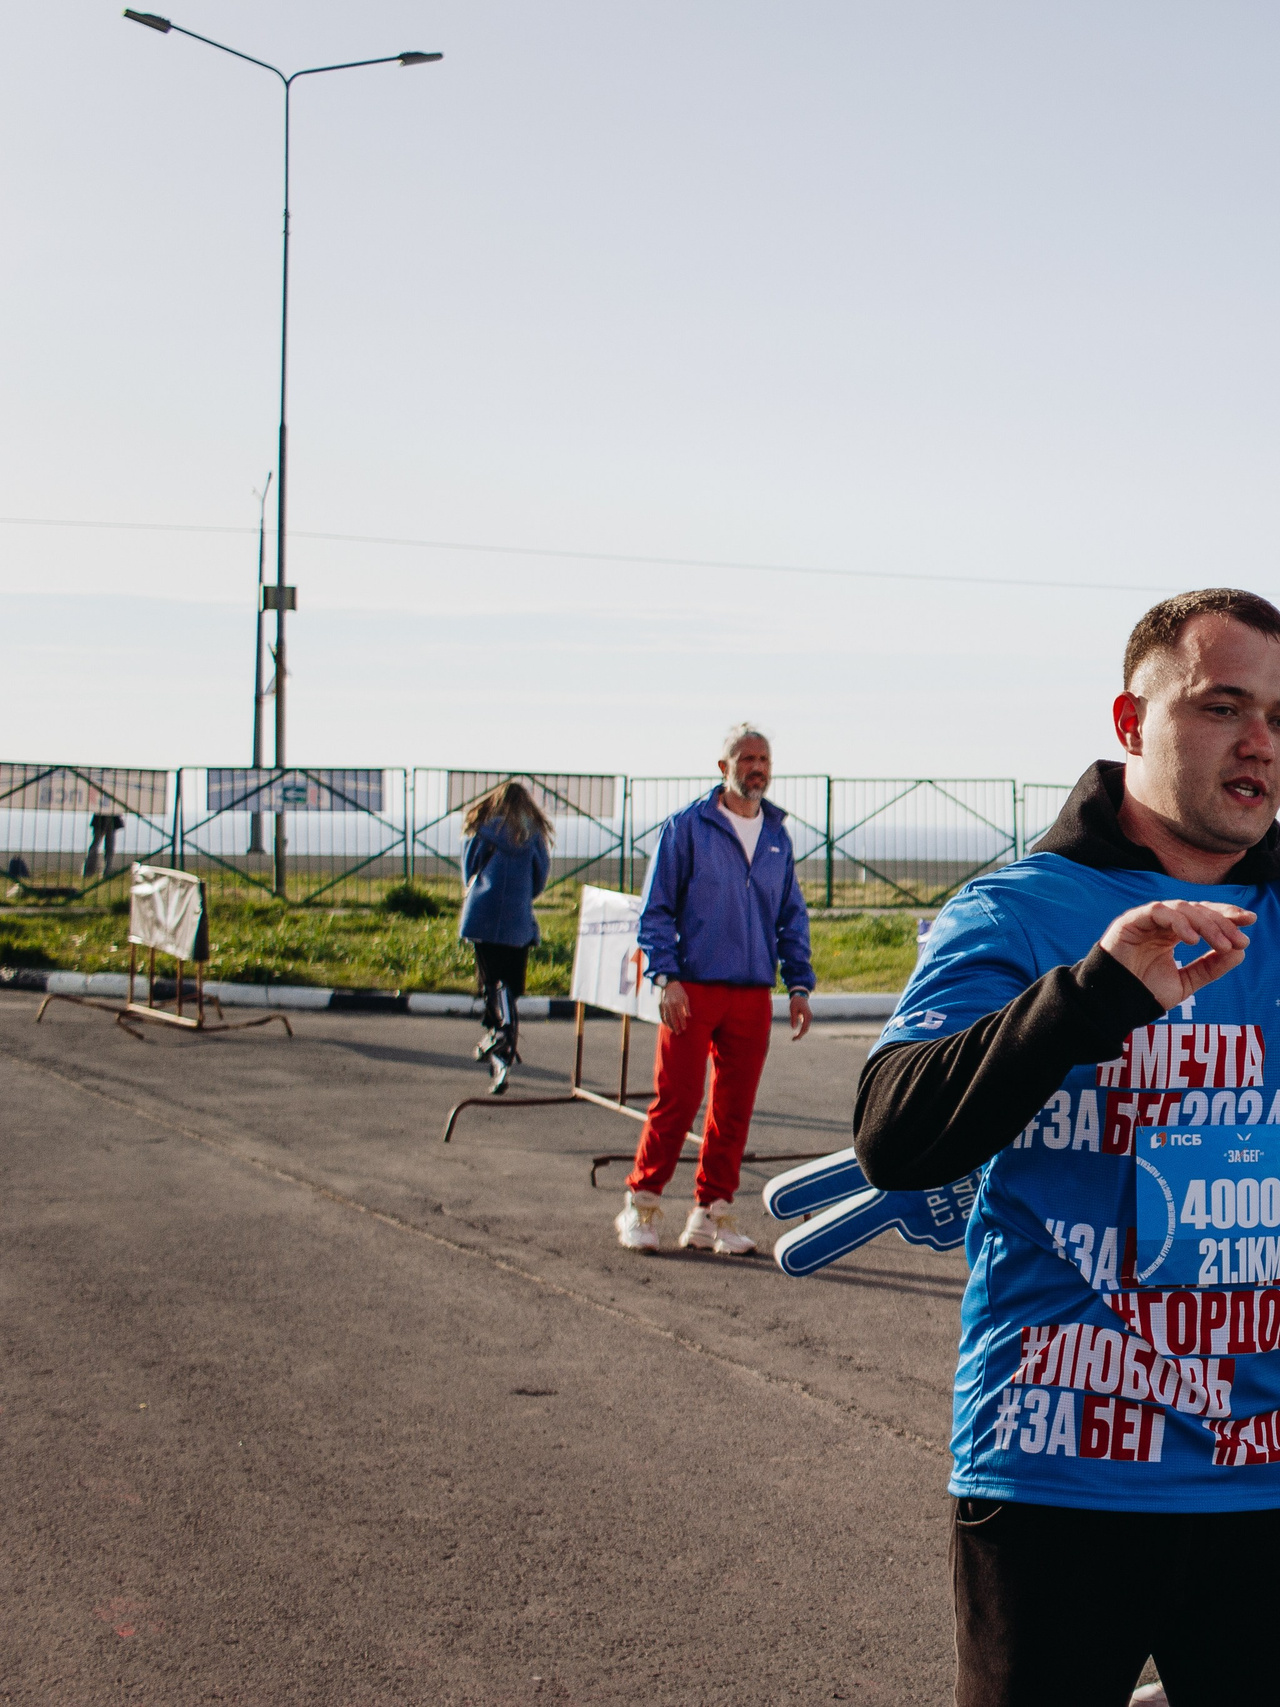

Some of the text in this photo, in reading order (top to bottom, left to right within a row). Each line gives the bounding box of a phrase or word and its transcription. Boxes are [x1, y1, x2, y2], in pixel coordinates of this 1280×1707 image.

[1097, 1023, 1264, 1088] #МЕЧТА
[1169, 1134, 1202, 1146] ПСБ
[923, 1186, 955, 1227] СТР
[1013, 1324, 1234, 1419] #ЛЮБОВЬ
[993, 1387, 1166, 1463] #ЗАБЕГ
